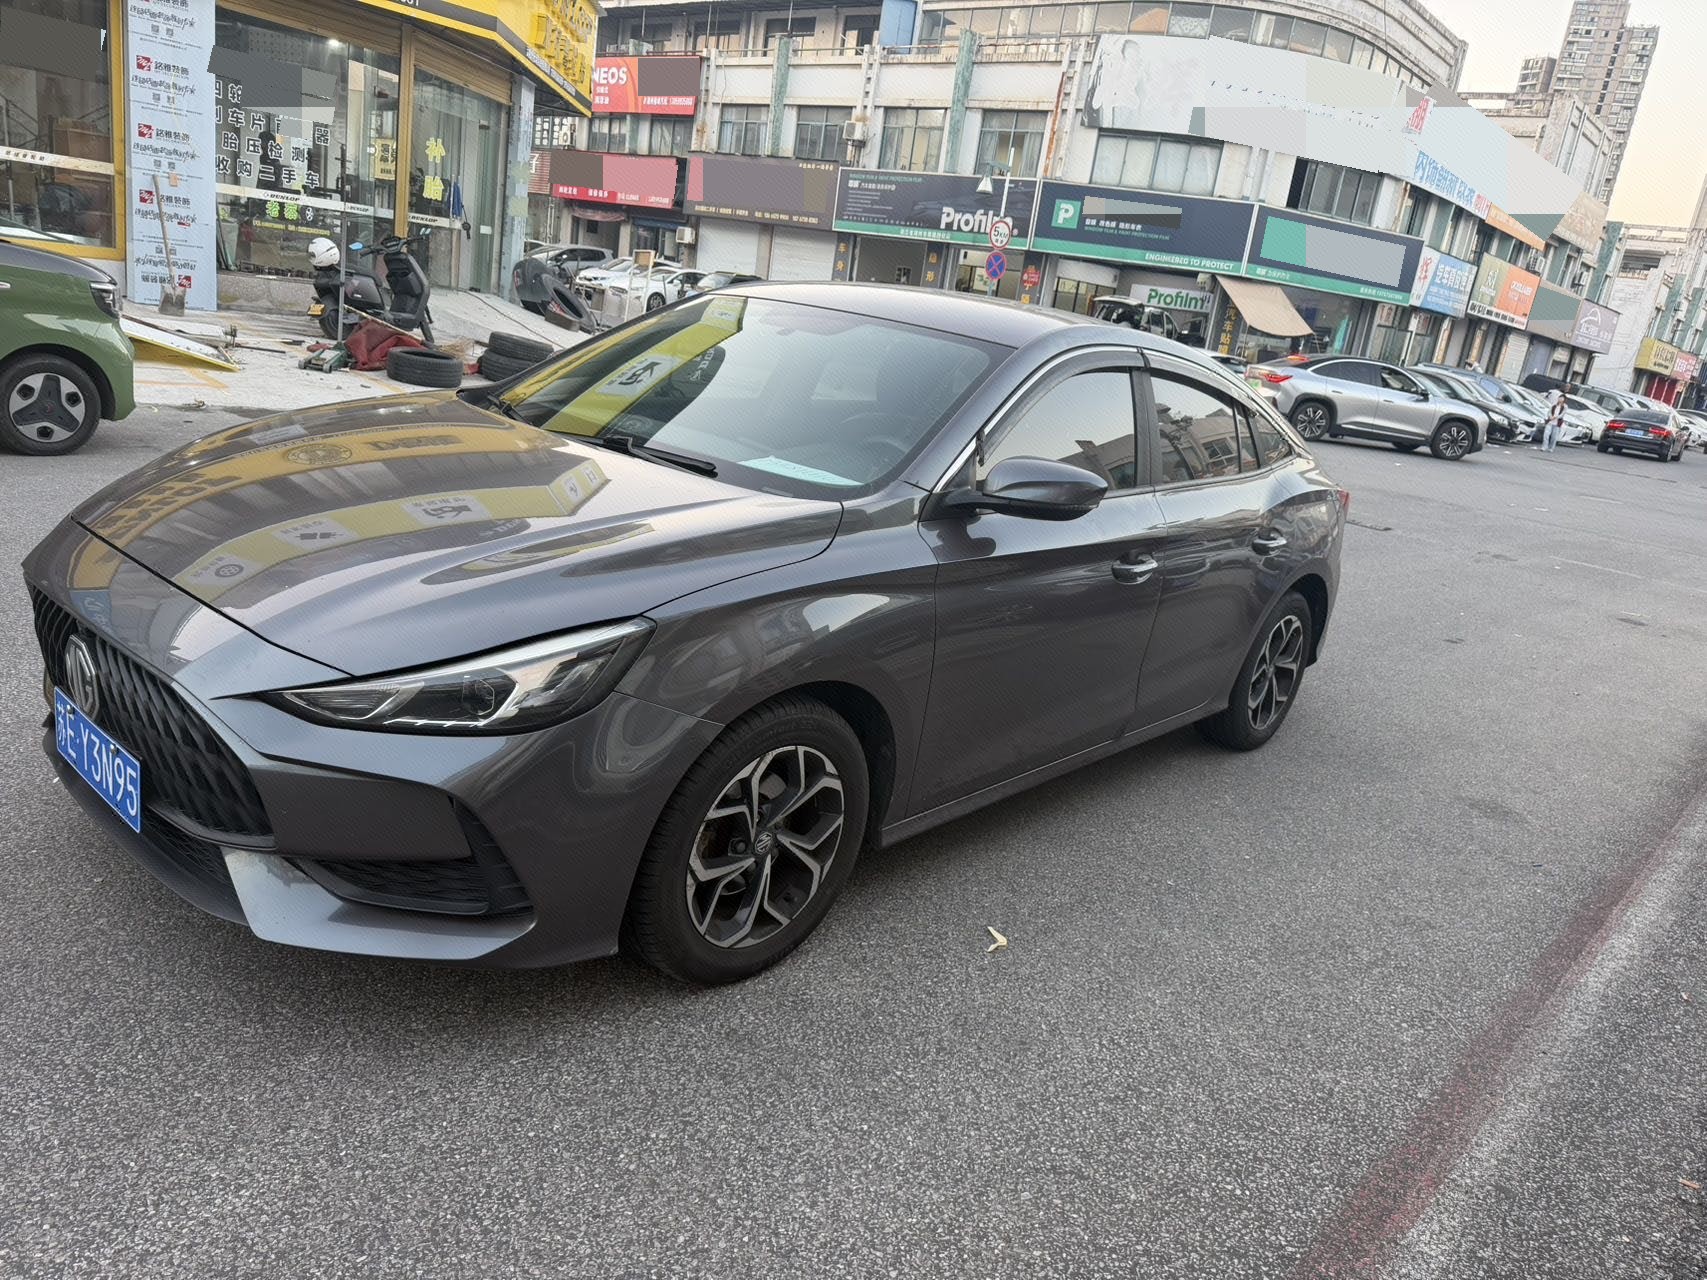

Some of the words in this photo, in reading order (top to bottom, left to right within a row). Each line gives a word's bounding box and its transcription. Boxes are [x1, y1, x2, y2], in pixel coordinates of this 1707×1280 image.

[215, 155, 319, 188] 收购二手车
[422, 137, 446, 201] 补胎
[1057, 203, 1074, 225] P
[1145, 252, 1189, 265] ENGINEERED
[1190, 258, 1200, 266] TO
[1201, 260, 1235, 271] PROTECT
[1146, 287, 1206, 311] Profilm
